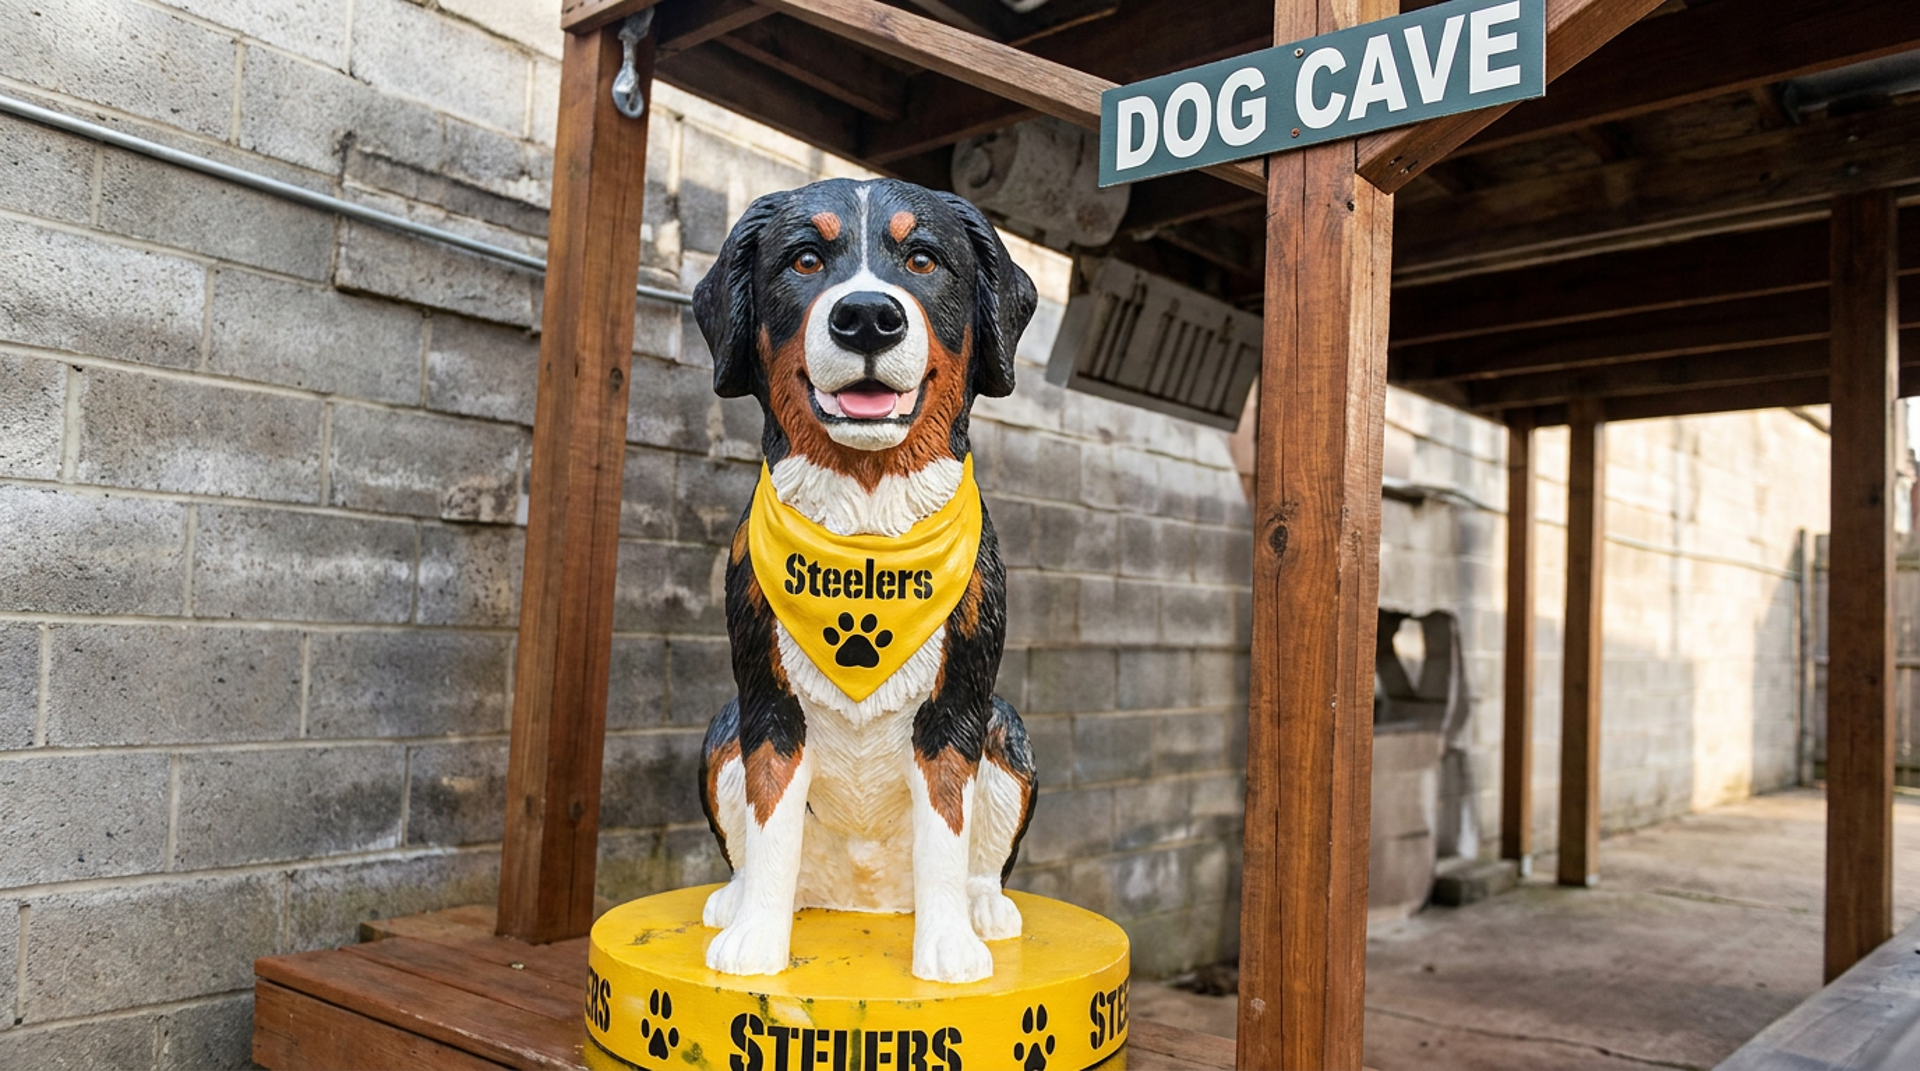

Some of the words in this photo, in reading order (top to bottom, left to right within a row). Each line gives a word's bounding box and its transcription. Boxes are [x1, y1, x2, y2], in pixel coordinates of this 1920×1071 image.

[1116, 66, 1267, 171] DOG
[1295, 0, 1521, 129] CAVE
[784, 552, 933, 600] Steelers
